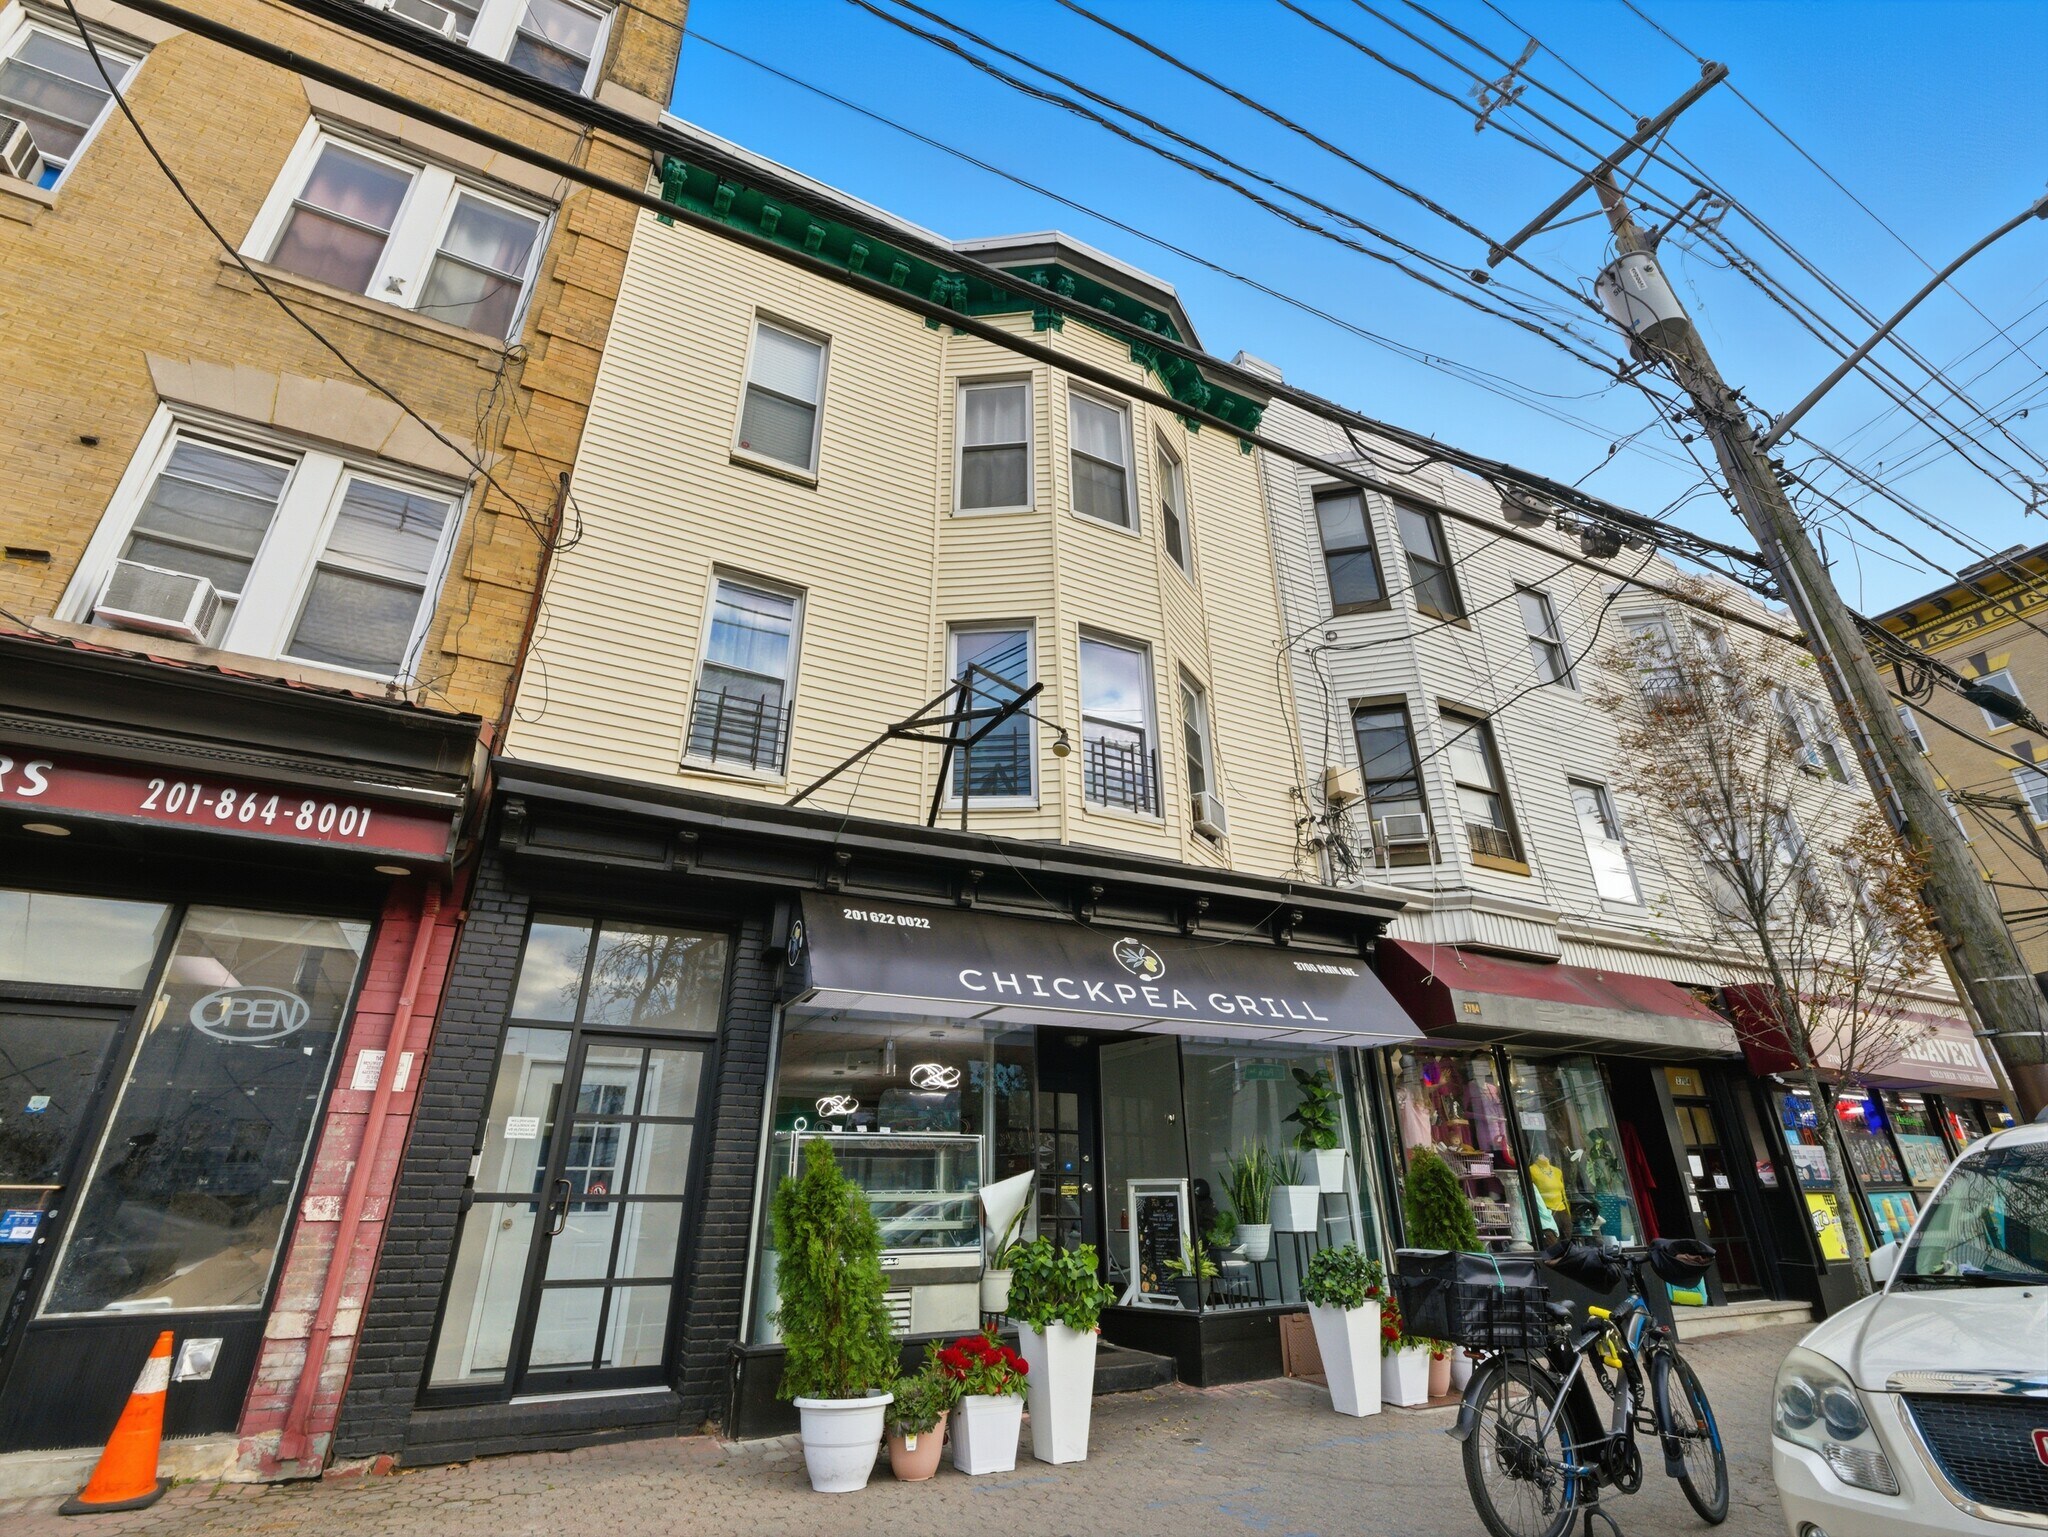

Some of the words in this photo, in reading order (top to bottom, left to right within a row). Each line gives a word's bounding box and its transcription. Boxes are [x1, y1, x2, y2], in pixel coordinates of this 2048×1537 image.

[139, 777, 372, 838] 201-864-8001
[843, 908, 868, 922] 201
[869, 912, 896, 925] 622
[896, 915, 931, 929] 0022
[191, 993, 307, 1034] OPEN
[958, 968, 1198, 1011] CHICKPEA
[1207, 993, 1329, 1022] GRILL
